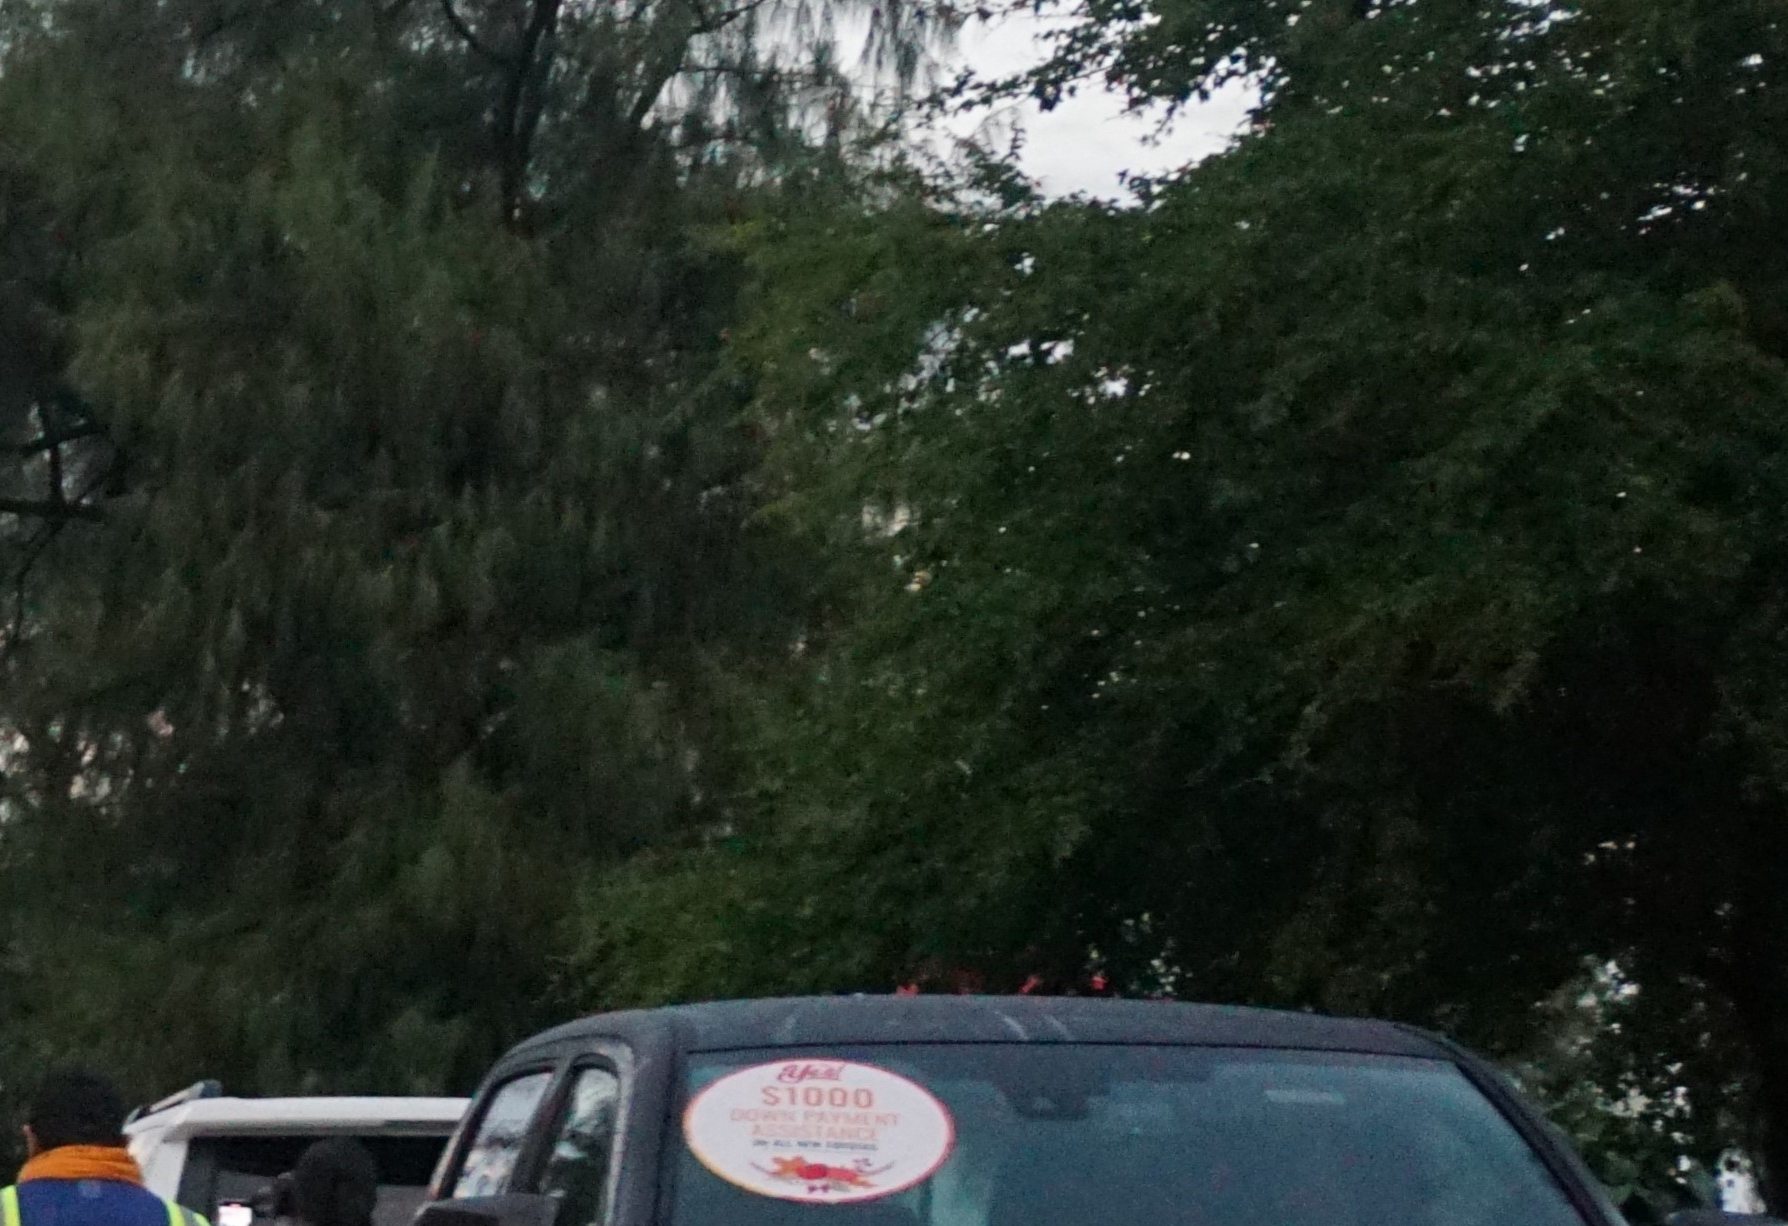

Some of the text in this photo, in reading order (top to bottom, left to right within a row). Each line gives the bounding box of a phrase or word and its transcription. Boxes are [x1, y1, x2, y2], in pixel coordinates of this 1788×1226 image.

[729, 1108, 900, 1126] DOWN PAYMENT
[751, 1123, 878, 1140] ASSISTANCE
